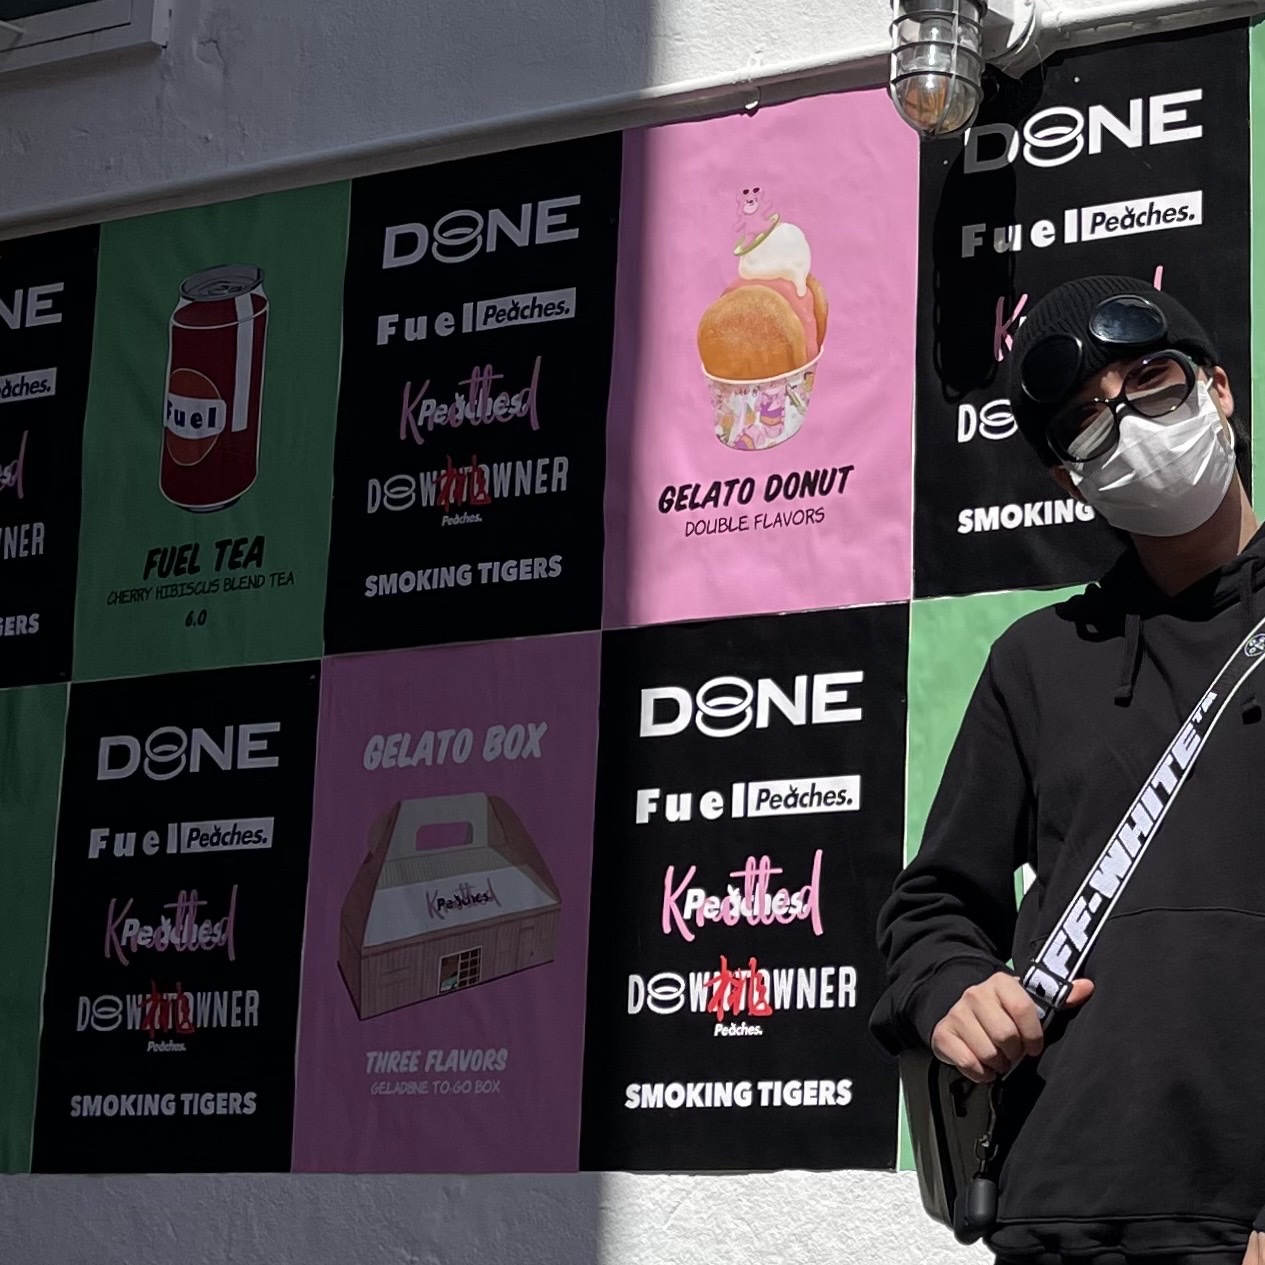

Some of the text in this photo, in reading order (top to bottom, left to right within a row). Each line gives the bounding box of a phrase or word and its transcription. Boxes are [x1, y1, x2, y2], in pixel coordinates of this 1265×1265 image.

[961, 208, 1078, 258] Fuel
[0, 282, 63, 329] NE
[377, 302, 474, 346] Fuel
[0, 376, 51, 399] aches.
[658, 465, 855, 514] GELATO DONUT
[685, 508, 826, 538] DOUBLE FLAVORS
[957, 498, 1096, 535] SMOKING
[143, 535, 266, 580] FUEL TEA
[107, 571, 295, 605] CHERRY HIBISCUS BLEND TEA
[364, 555, 563, 597] SMOKING TIGERS
[185, 609, 207, 627] 6.0
[363, 722, 548, 770] GELATO BOX
[635, 783, 744, 824] Fuel
[88, 823, 178, 858] Fuel
[365, 1048, 507, 1073] THREE FLAVORS
[70, 1091, 257, 1117] SMOKING TIGERS
[474, 1079, 501, 1094] BOX
[625, 1079, 852, 1109] SMOKING TIGERS
